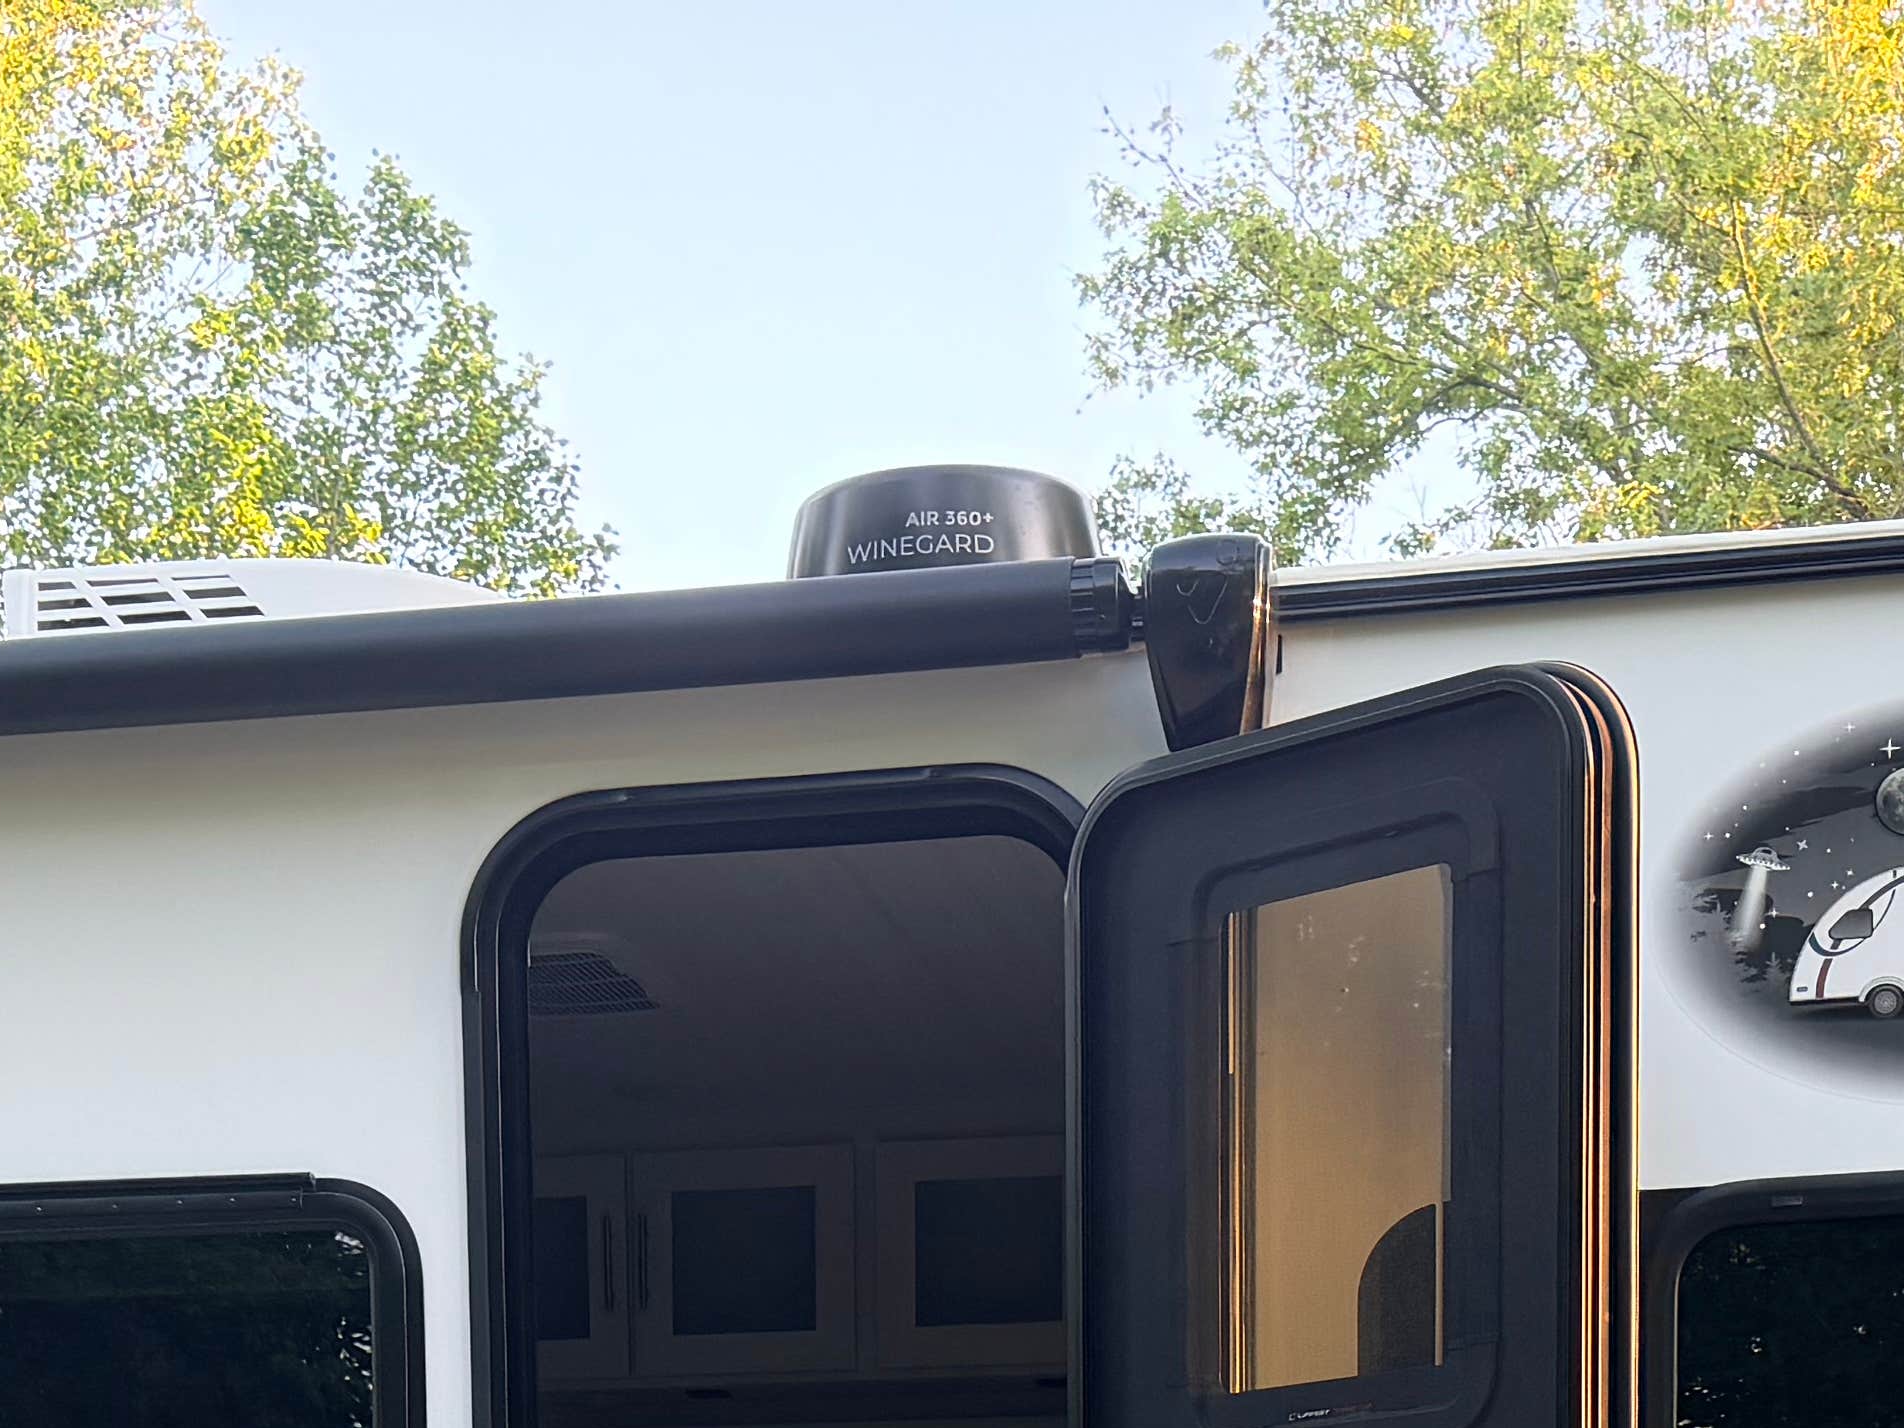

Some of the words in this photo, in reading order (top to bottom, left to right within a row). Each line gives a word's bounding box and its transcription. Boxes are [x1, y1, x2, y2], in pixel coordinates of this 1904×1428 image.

[905, 511, 939, 527] AIR
[945, 510, 994, 526] 360+
[847, 534, 995, 564] WINEGARD
